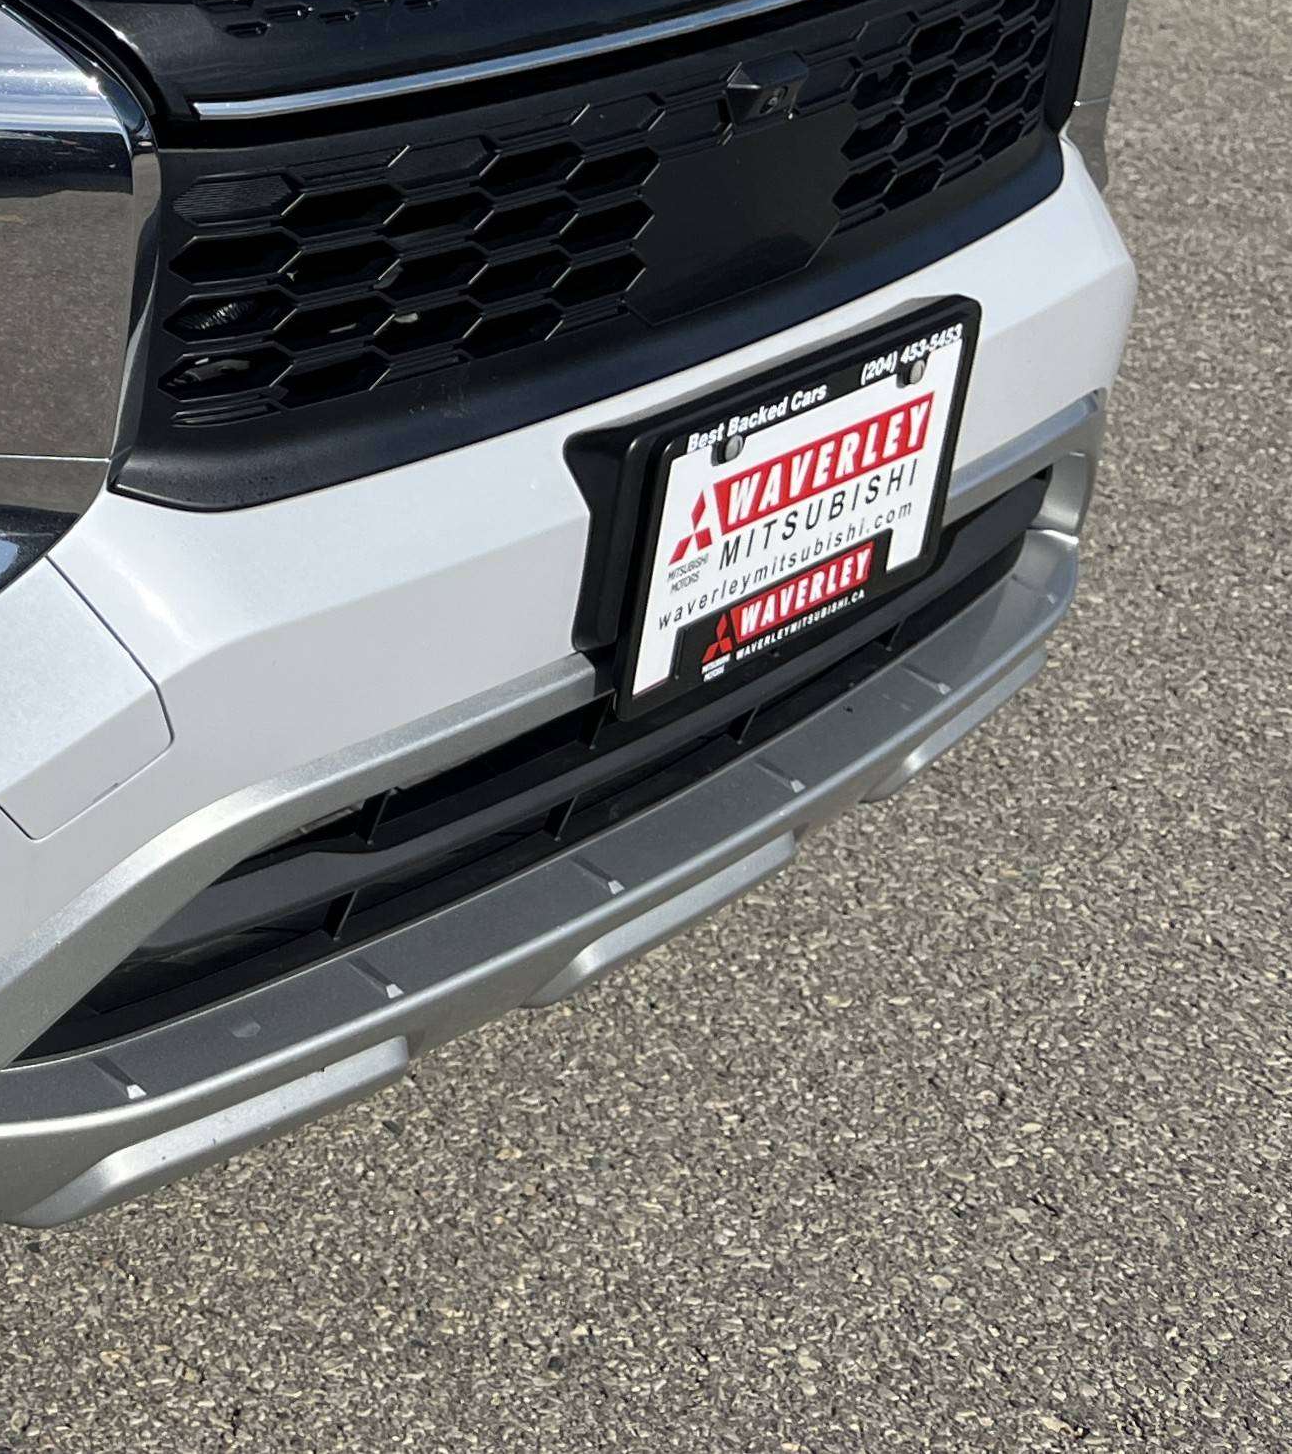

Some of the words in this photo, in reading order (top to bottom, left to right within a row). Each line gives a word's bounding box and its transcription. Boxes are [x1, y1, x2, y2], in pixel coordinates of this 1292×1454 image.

[860, 351, 898, 386] (204)
[900, 322, 964, 365] 453-5453
[687, 426, 725, 454] Best
[727, 395, 787, 438] Backed
[791, 383, 828, 410] Cars
[726, 400, 931, 526] WAVERLEY
[718, 457, 918, 571] MITSUBISHI
[658, 500, 913, 631] waverleymitsubishi.com
[740, 548, 874, 637] WAVERLEY
[735, 588, 865, 661] WAVERLEYMITSUBISHI.CA
